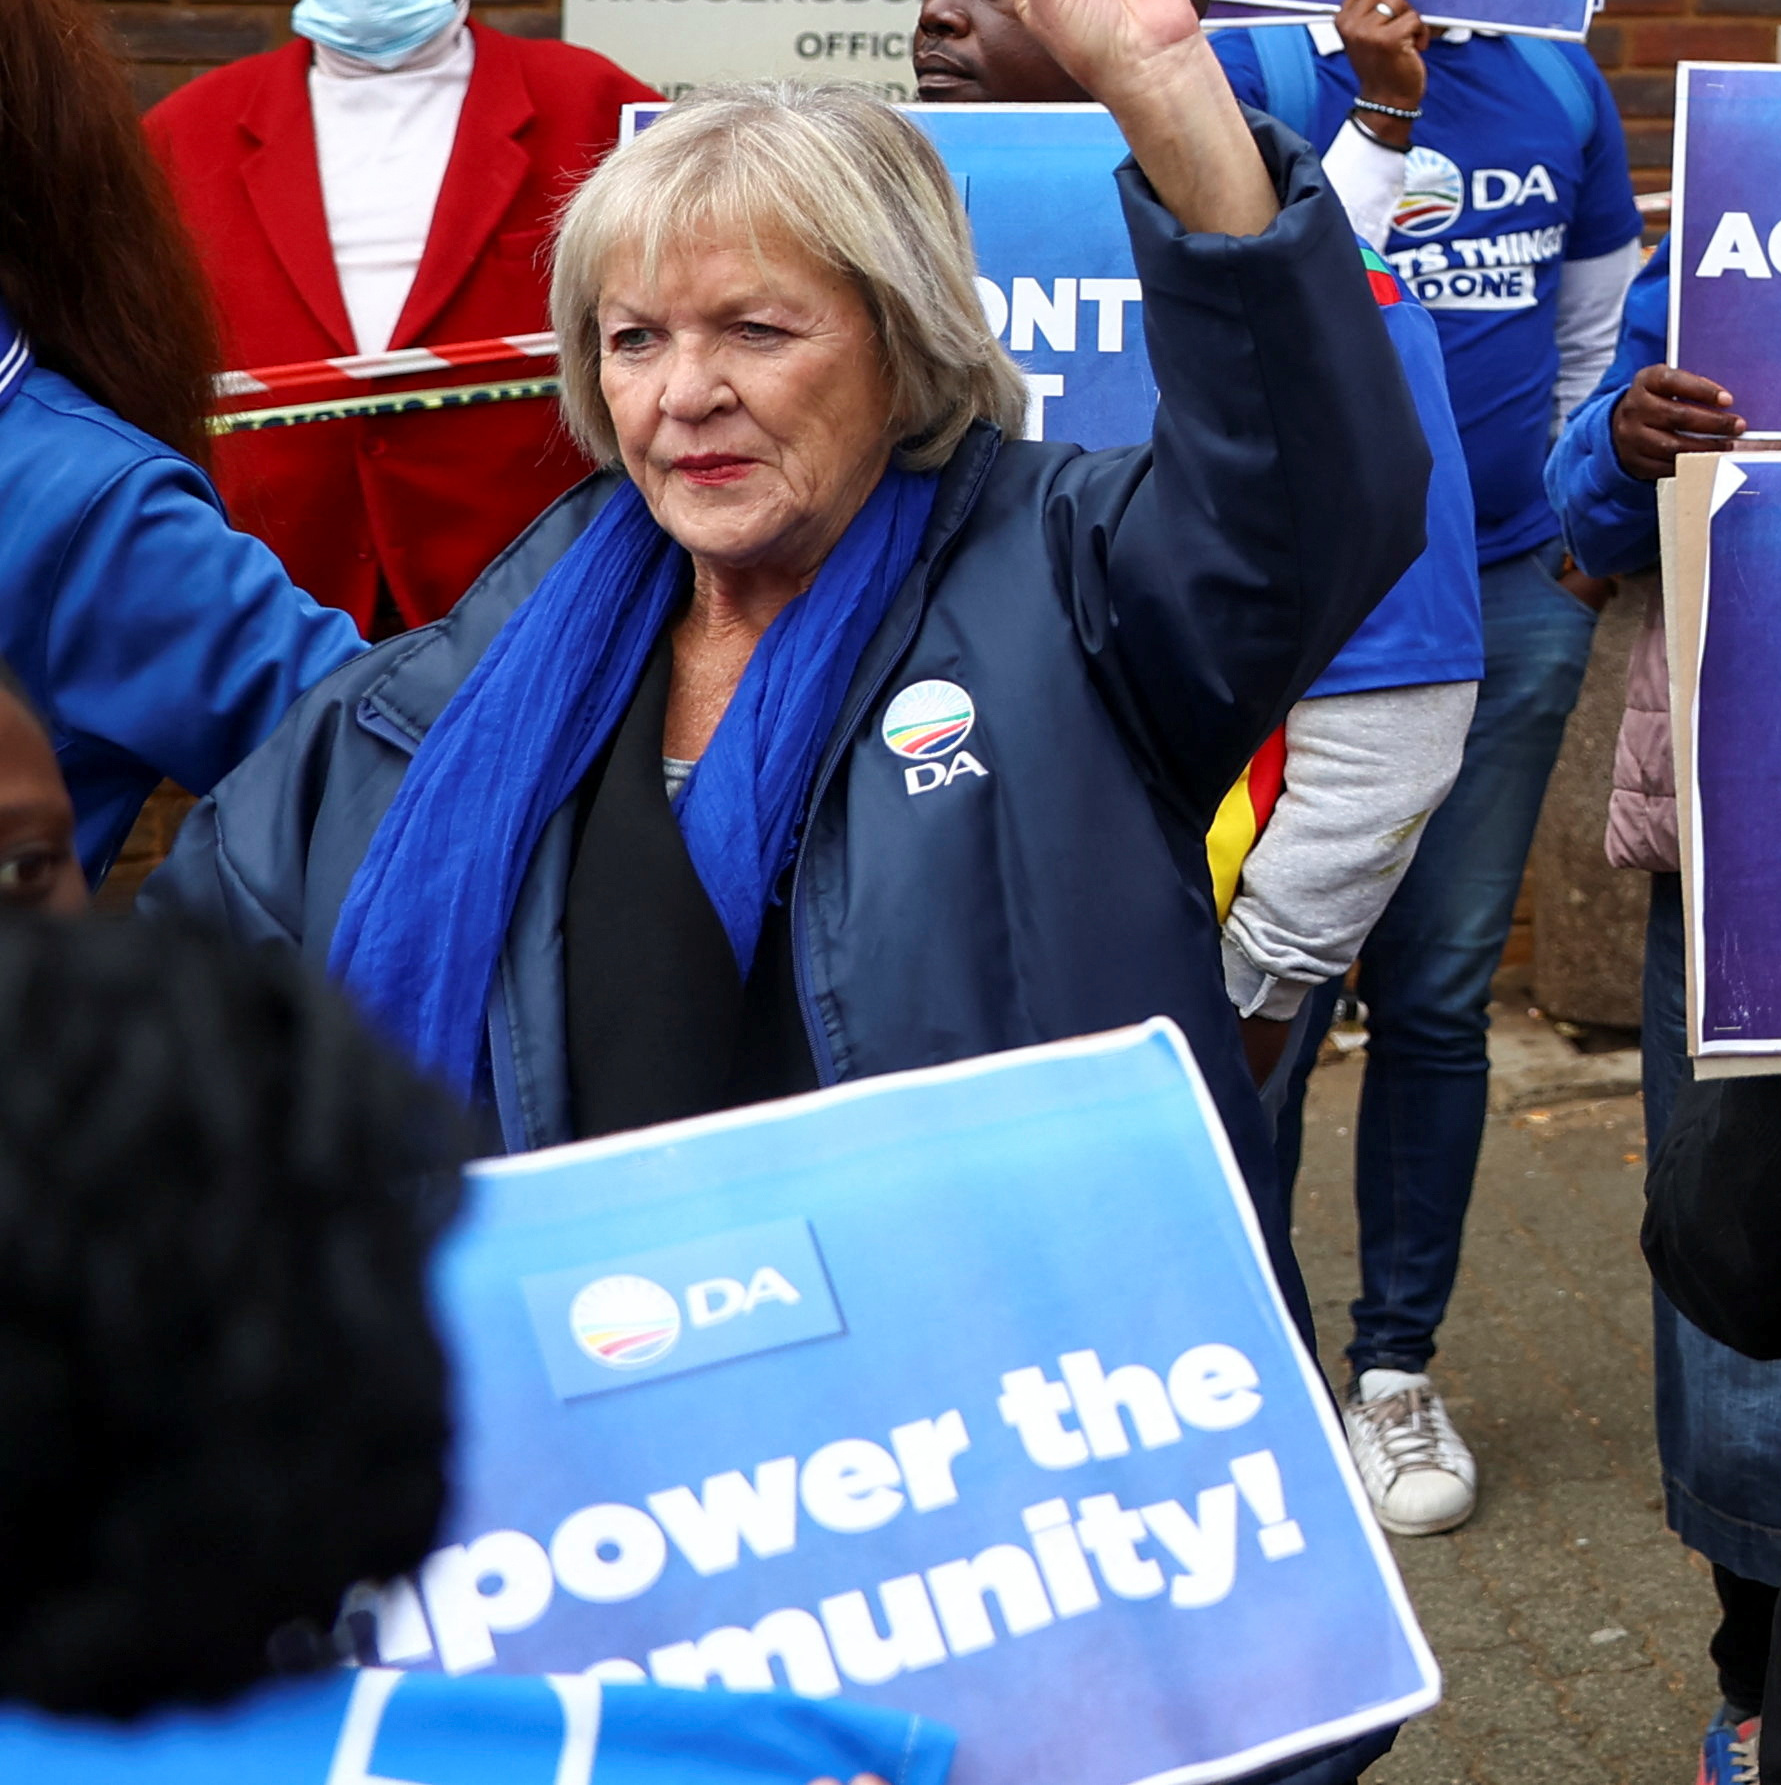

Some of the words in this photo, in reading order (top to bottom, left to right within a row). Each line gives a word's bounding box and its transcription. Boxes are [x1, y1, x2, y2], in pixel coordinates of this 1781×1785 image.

[795, 31, 914, 58] OFFIC
[1471, 164, 1558, 211] DA
[1417, 271, 1523, 301] DONE
[904, 750, 989, 796] DA
[686, 1265, 802, 1330] DA
[1003, 1341, 1262, 1471] the
